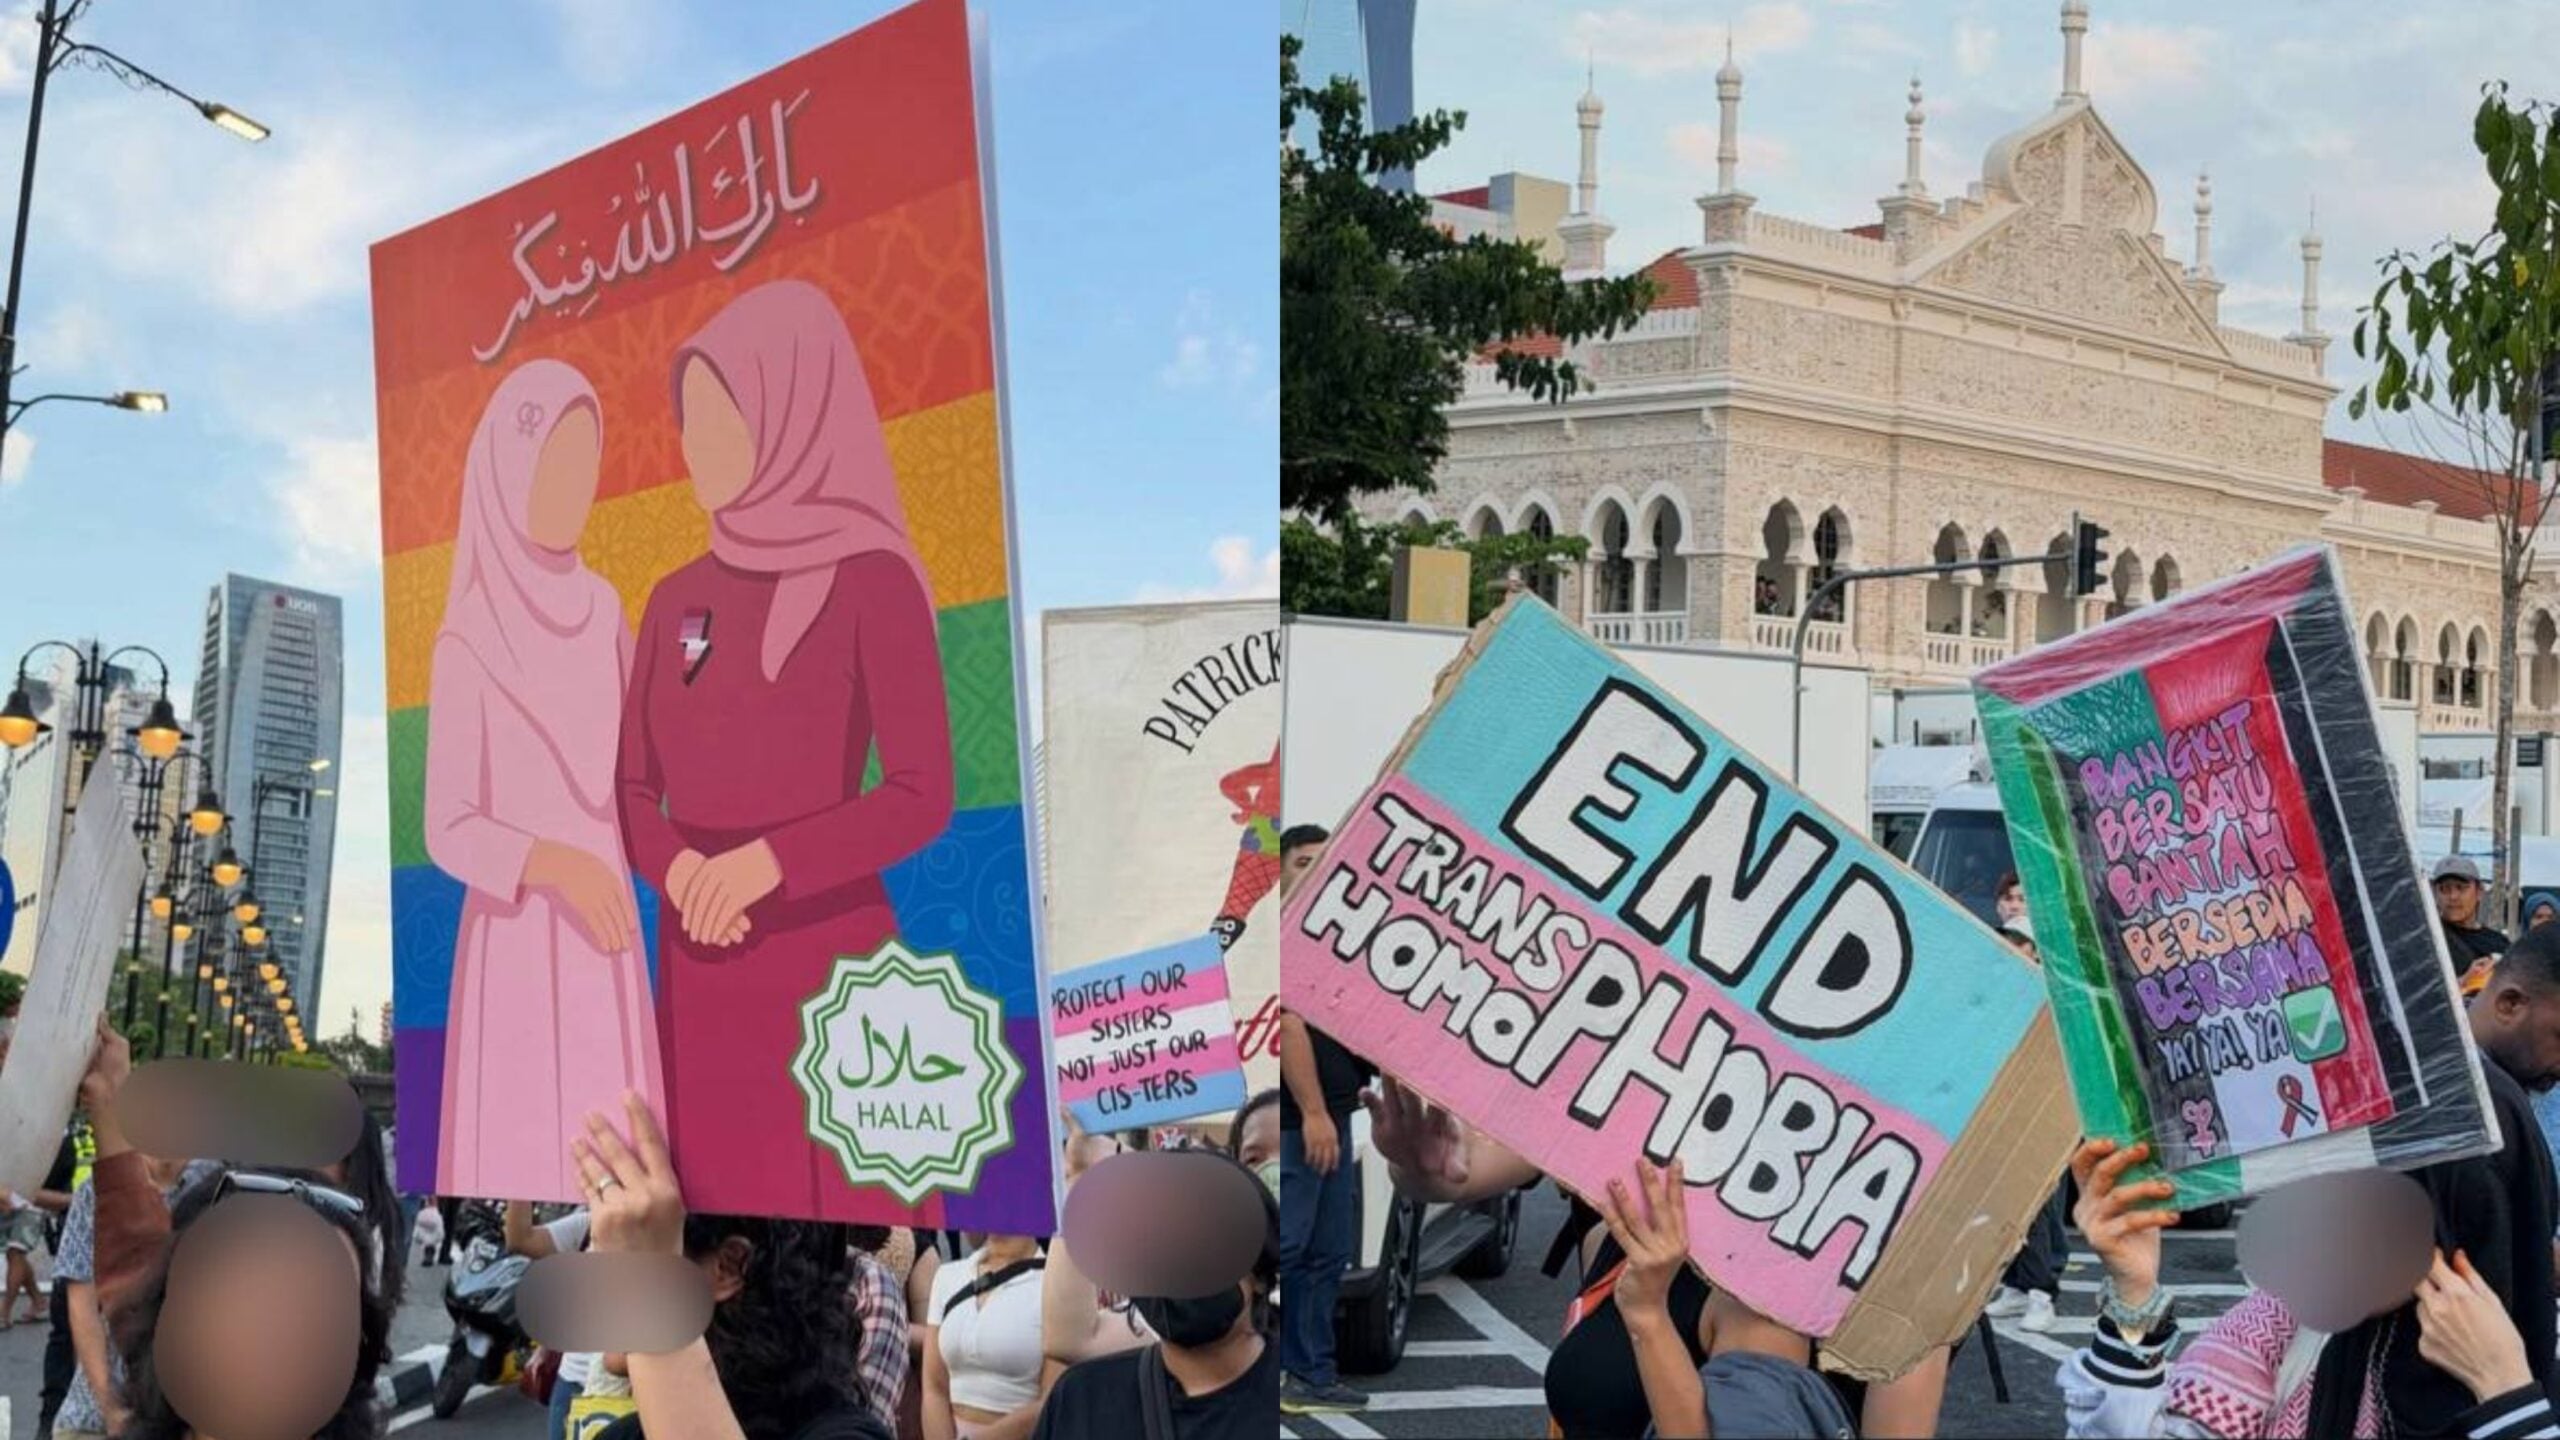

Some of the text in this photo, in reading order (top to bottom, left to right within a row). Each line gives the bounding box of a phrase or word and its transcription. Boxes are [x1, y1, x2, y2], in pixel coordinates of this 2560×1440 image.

[2079, 700, 2254, 808] BANGKIT
[2095, 754, 2274, 862] BERSATU
[1500, 677, 1913, 1039] END
[2107, 809, 2297, 918] BANTAH
[2121, 876, 2315, 976] BERSEDIA
[1052, 962, 1188, 1019] ROTECT OUR
[2135, 929, 2331, 1032] BERSAMA
[838, 1013, 967, 1089] حلال
[1057, 1029, 1210, 1083] NOT JUST OUR
[1090, 1003, 1173, 1043] SISTERS
[2202, 1016, 2254, 1075] YA!
[2244, 1009, 2290, 1063] YA
[857, 1101, 952, 1132] HALAL
[1097, 1068, 1198, 1115] CIS-TERS
